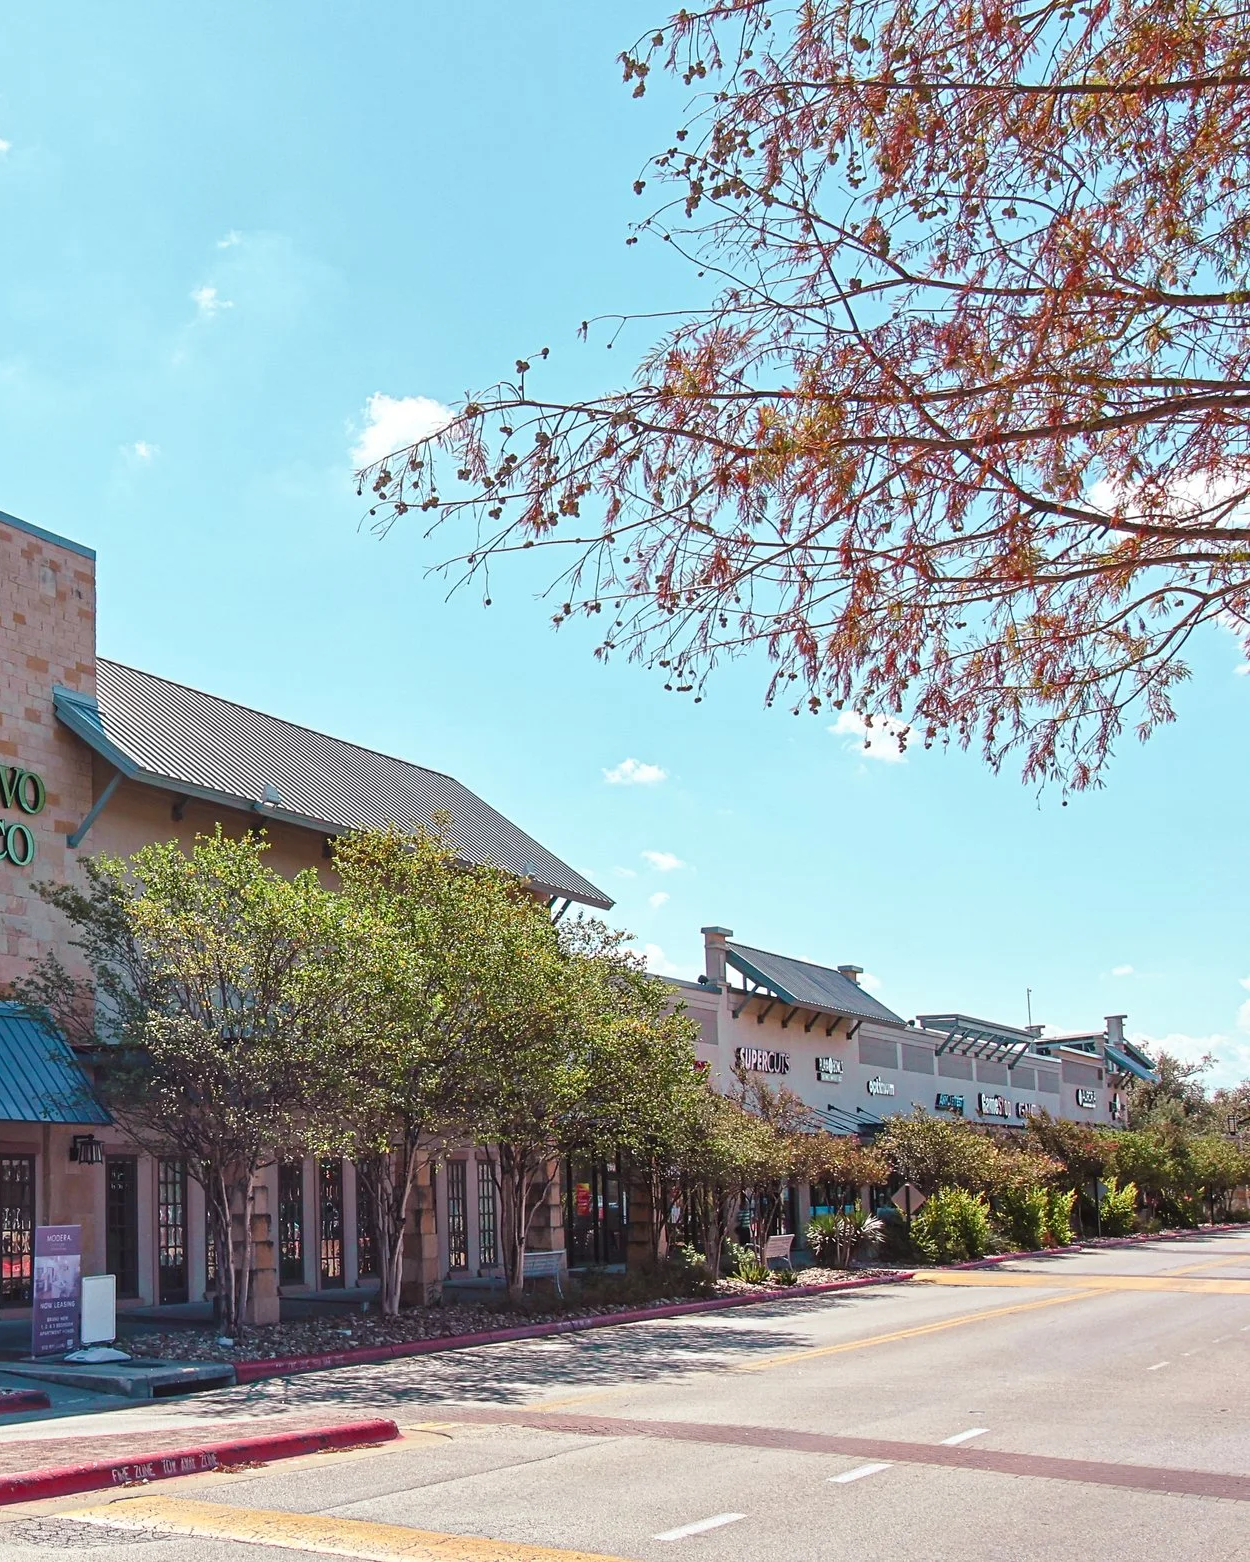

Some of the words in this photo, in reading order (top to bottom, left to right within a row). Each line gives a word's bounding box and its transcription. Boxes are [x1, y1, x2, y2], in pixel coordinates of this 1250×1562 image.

[737, 1047, 791, 1075] SUPERCUTS
[134, 1462, 156, 1479] ZONE
[199, 1452, 218, 1469] ZONE
